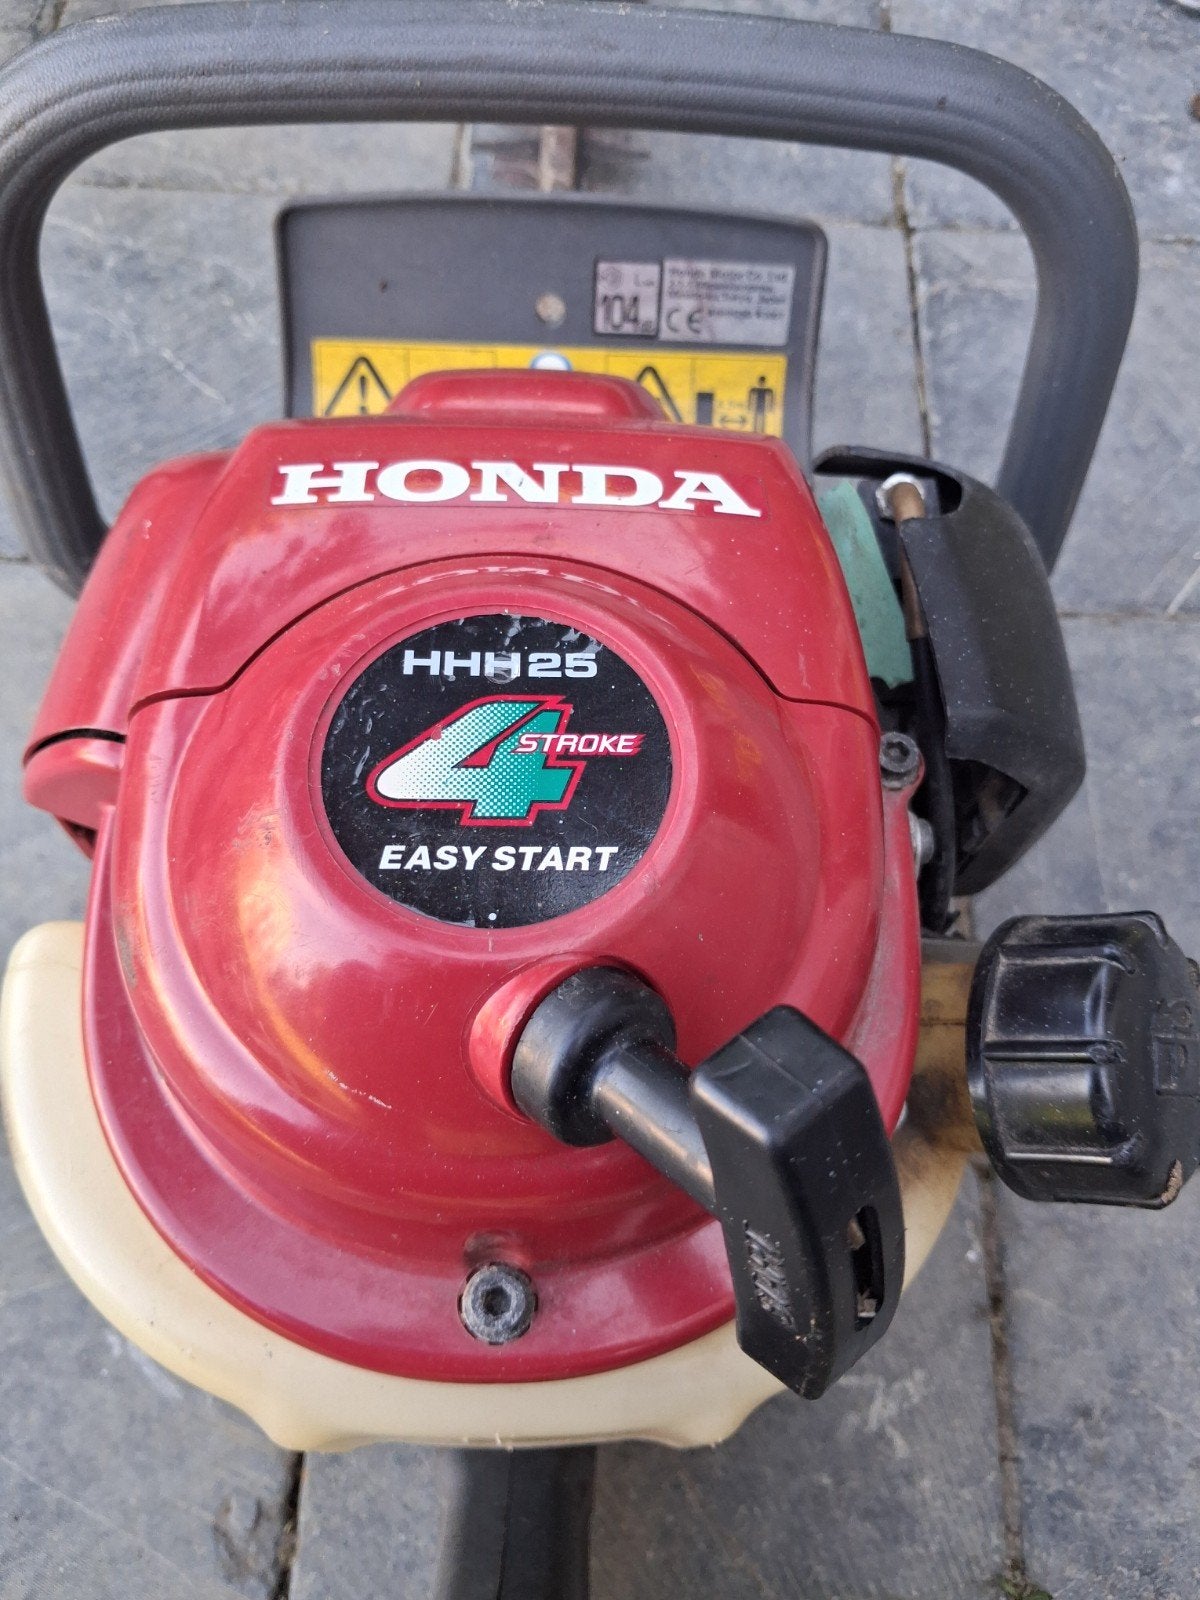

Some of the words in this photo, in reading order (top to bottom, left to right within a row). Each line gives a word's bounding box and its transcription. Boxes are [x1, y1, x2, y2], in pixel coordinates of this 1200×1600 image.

[601, 293, 640, 329] 104
[271, 460, 763, 517] HONDA
[403, 650, 598, 678] HHH25
[366, 695, 586, 826] 4
[514, 733, 638, 754] STROKE
[378, 845, 487, 871] EASY
[491, 846, 619, 871] START
